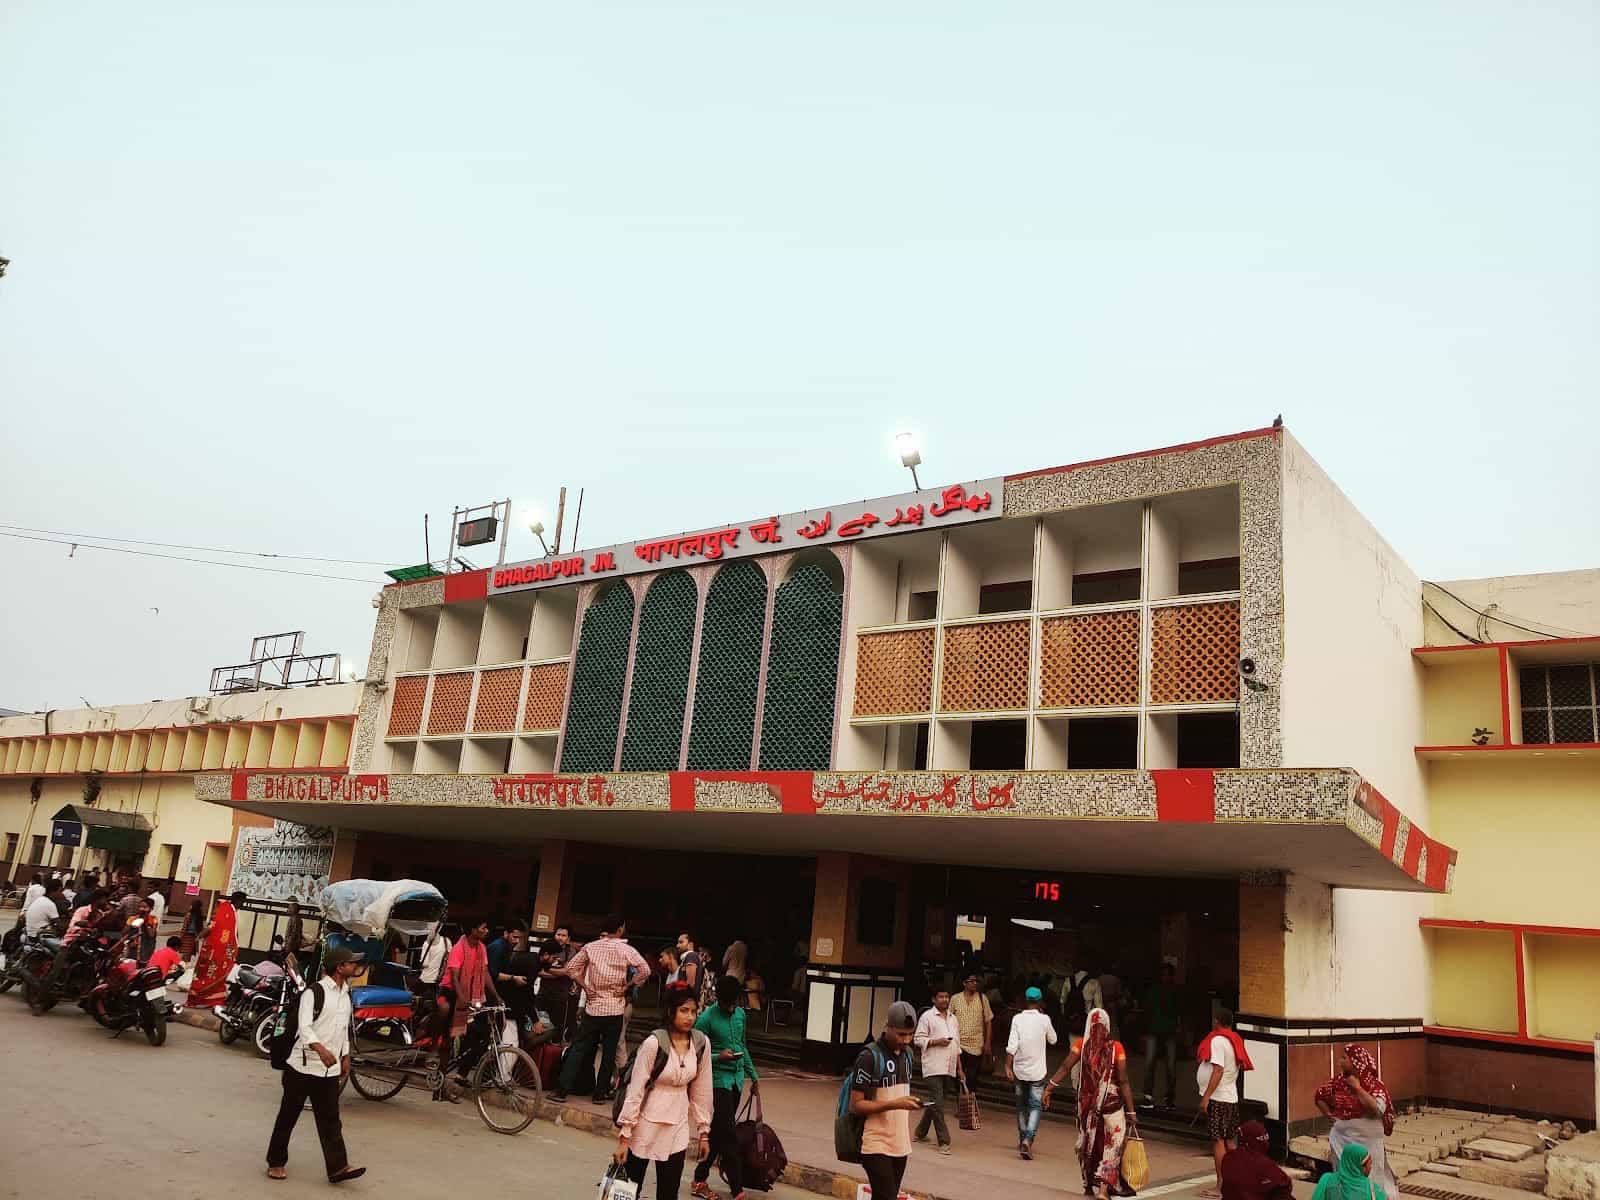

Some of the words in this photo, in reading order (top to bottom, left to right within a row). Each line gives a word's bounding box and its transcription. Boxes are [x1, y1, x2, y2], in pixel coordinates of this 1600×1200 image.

[634, 528, 740, 562] भागलपुर
[493, 556, 585, 588] BHAGALPUR
[264, 775, 363, 801] BHAGALPUR
